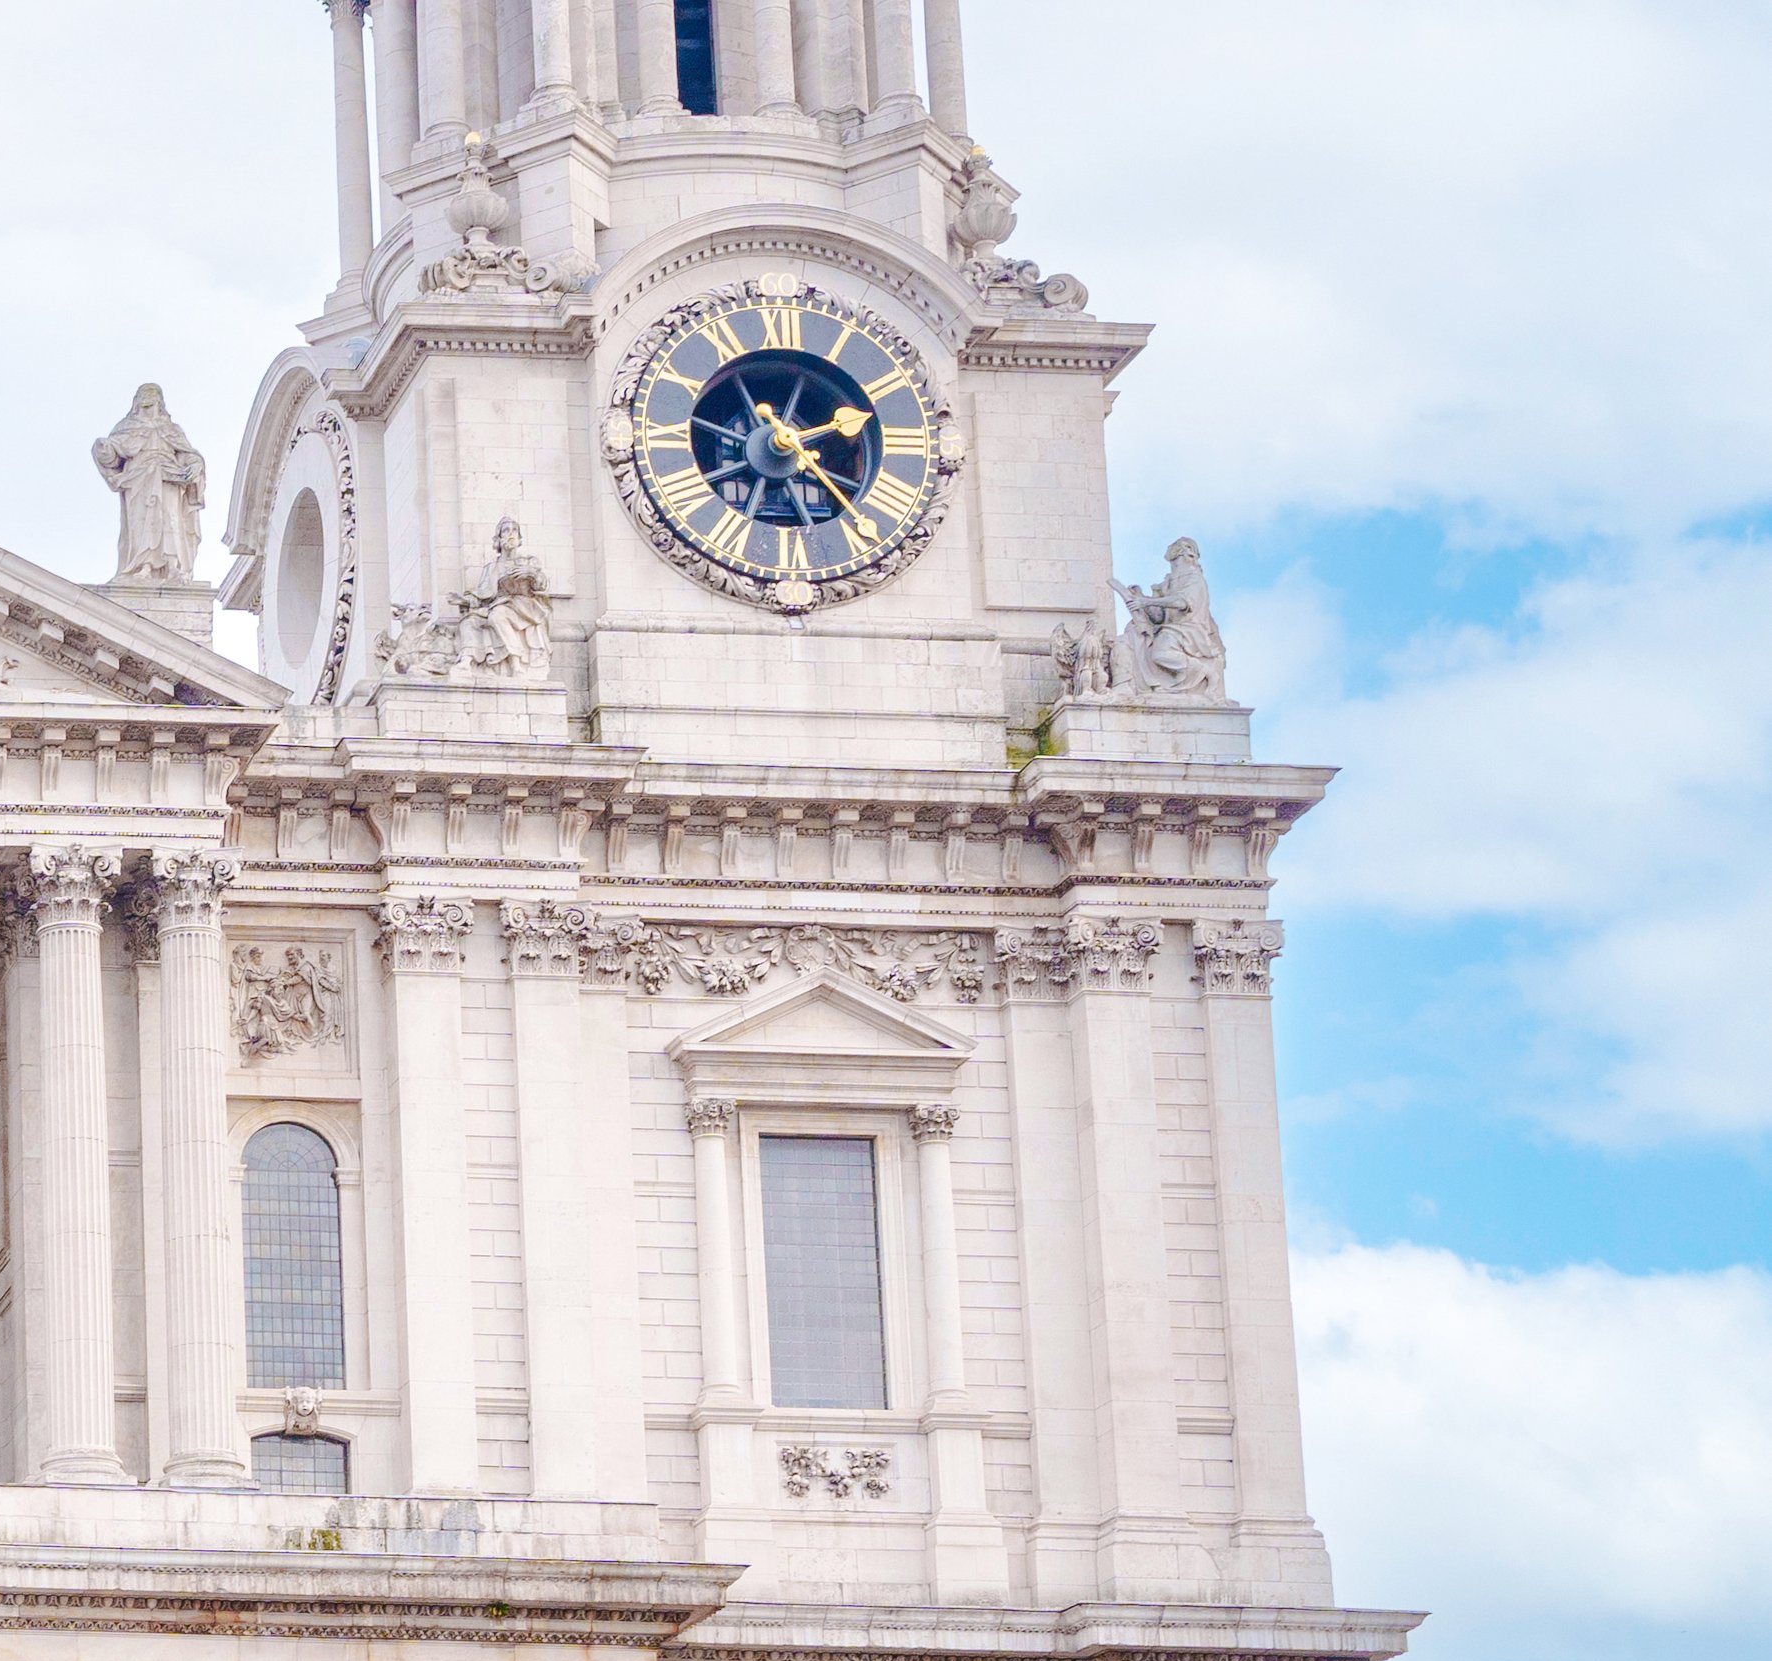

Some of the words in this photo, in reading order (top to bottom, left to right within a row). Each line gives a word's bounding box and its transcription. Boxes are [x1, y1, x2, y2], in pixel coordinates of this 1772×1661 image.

[760, 272, 798, 297] 60
[697, 317, 749, 367] XI
[758, 309, 803, 350] XII
[861, 366, 912, 404] II
[882, 426, 926, 457] III
[780, 583, 814, 605] 30
